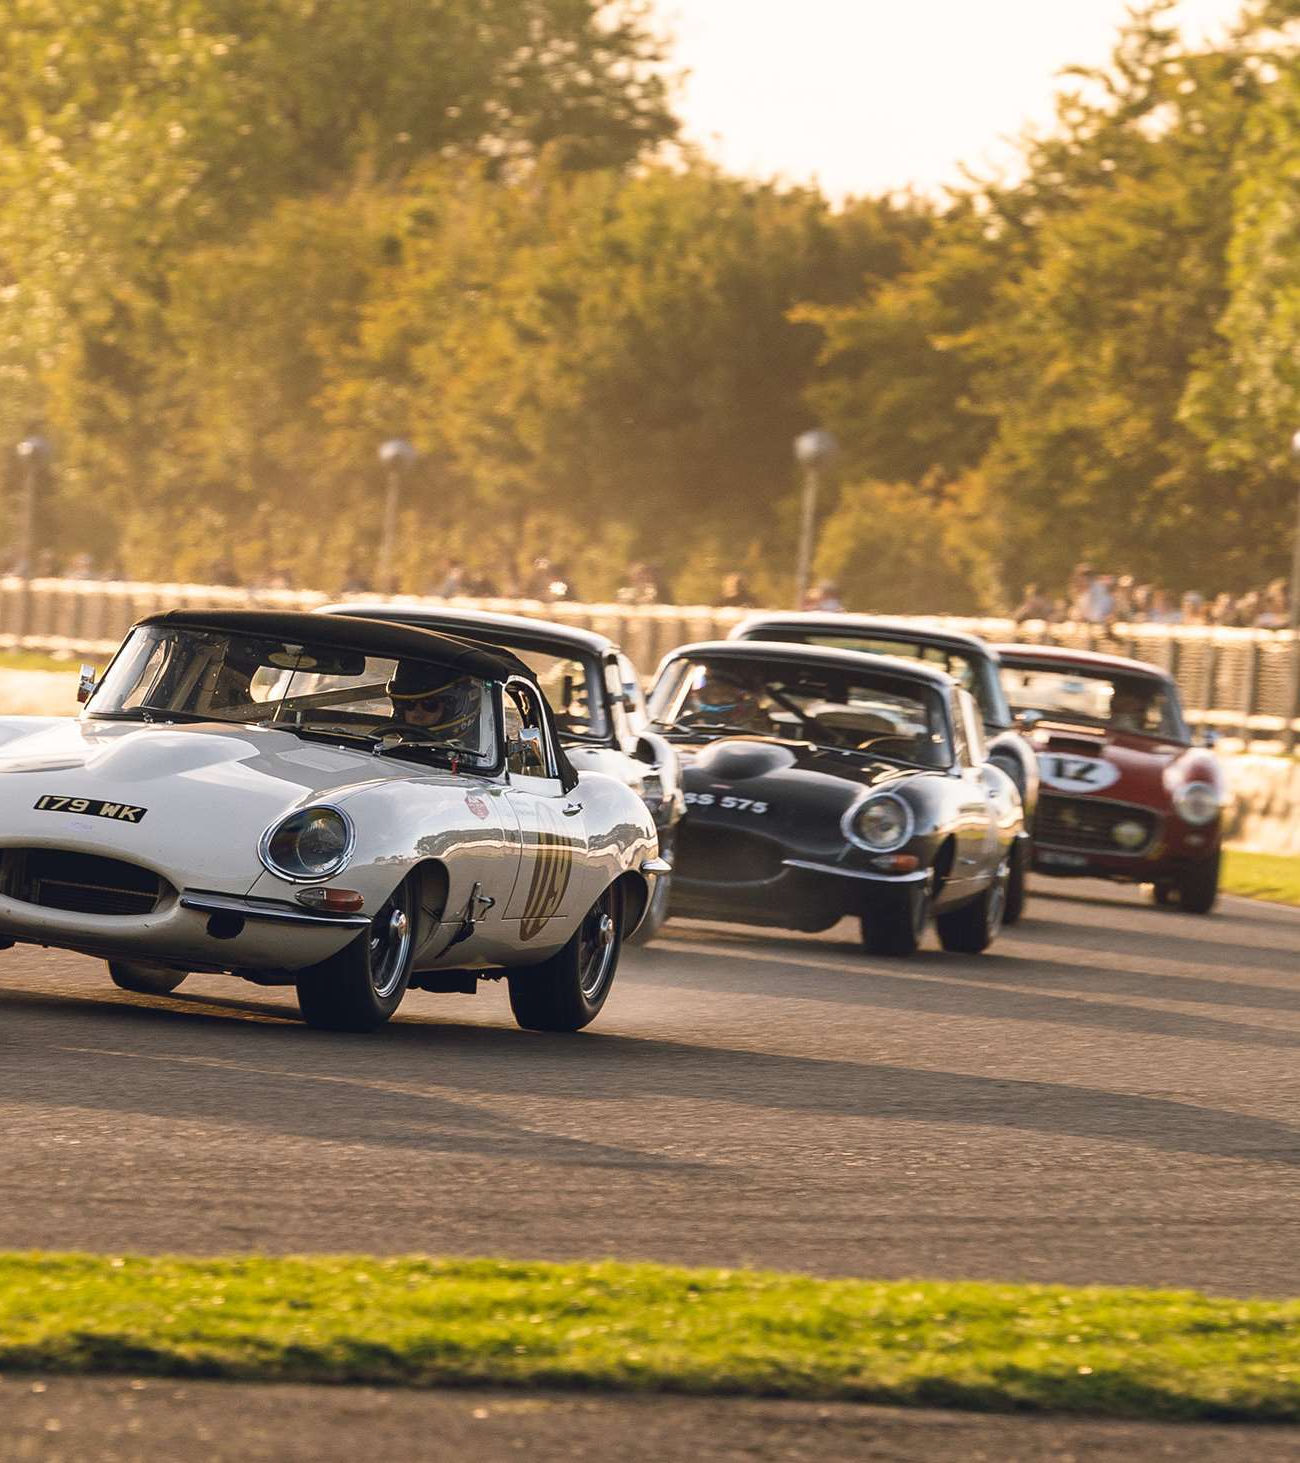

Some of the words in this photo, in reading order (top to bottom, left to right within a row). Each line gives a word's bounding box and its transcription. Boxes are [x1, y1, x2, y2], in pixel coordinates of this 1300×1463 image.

[1050, 757, 1099, 784] 12
[37, 796, 90, 812] 179
[99, 803, 142, 822] WK
[720, 796, 769, 814] 575
